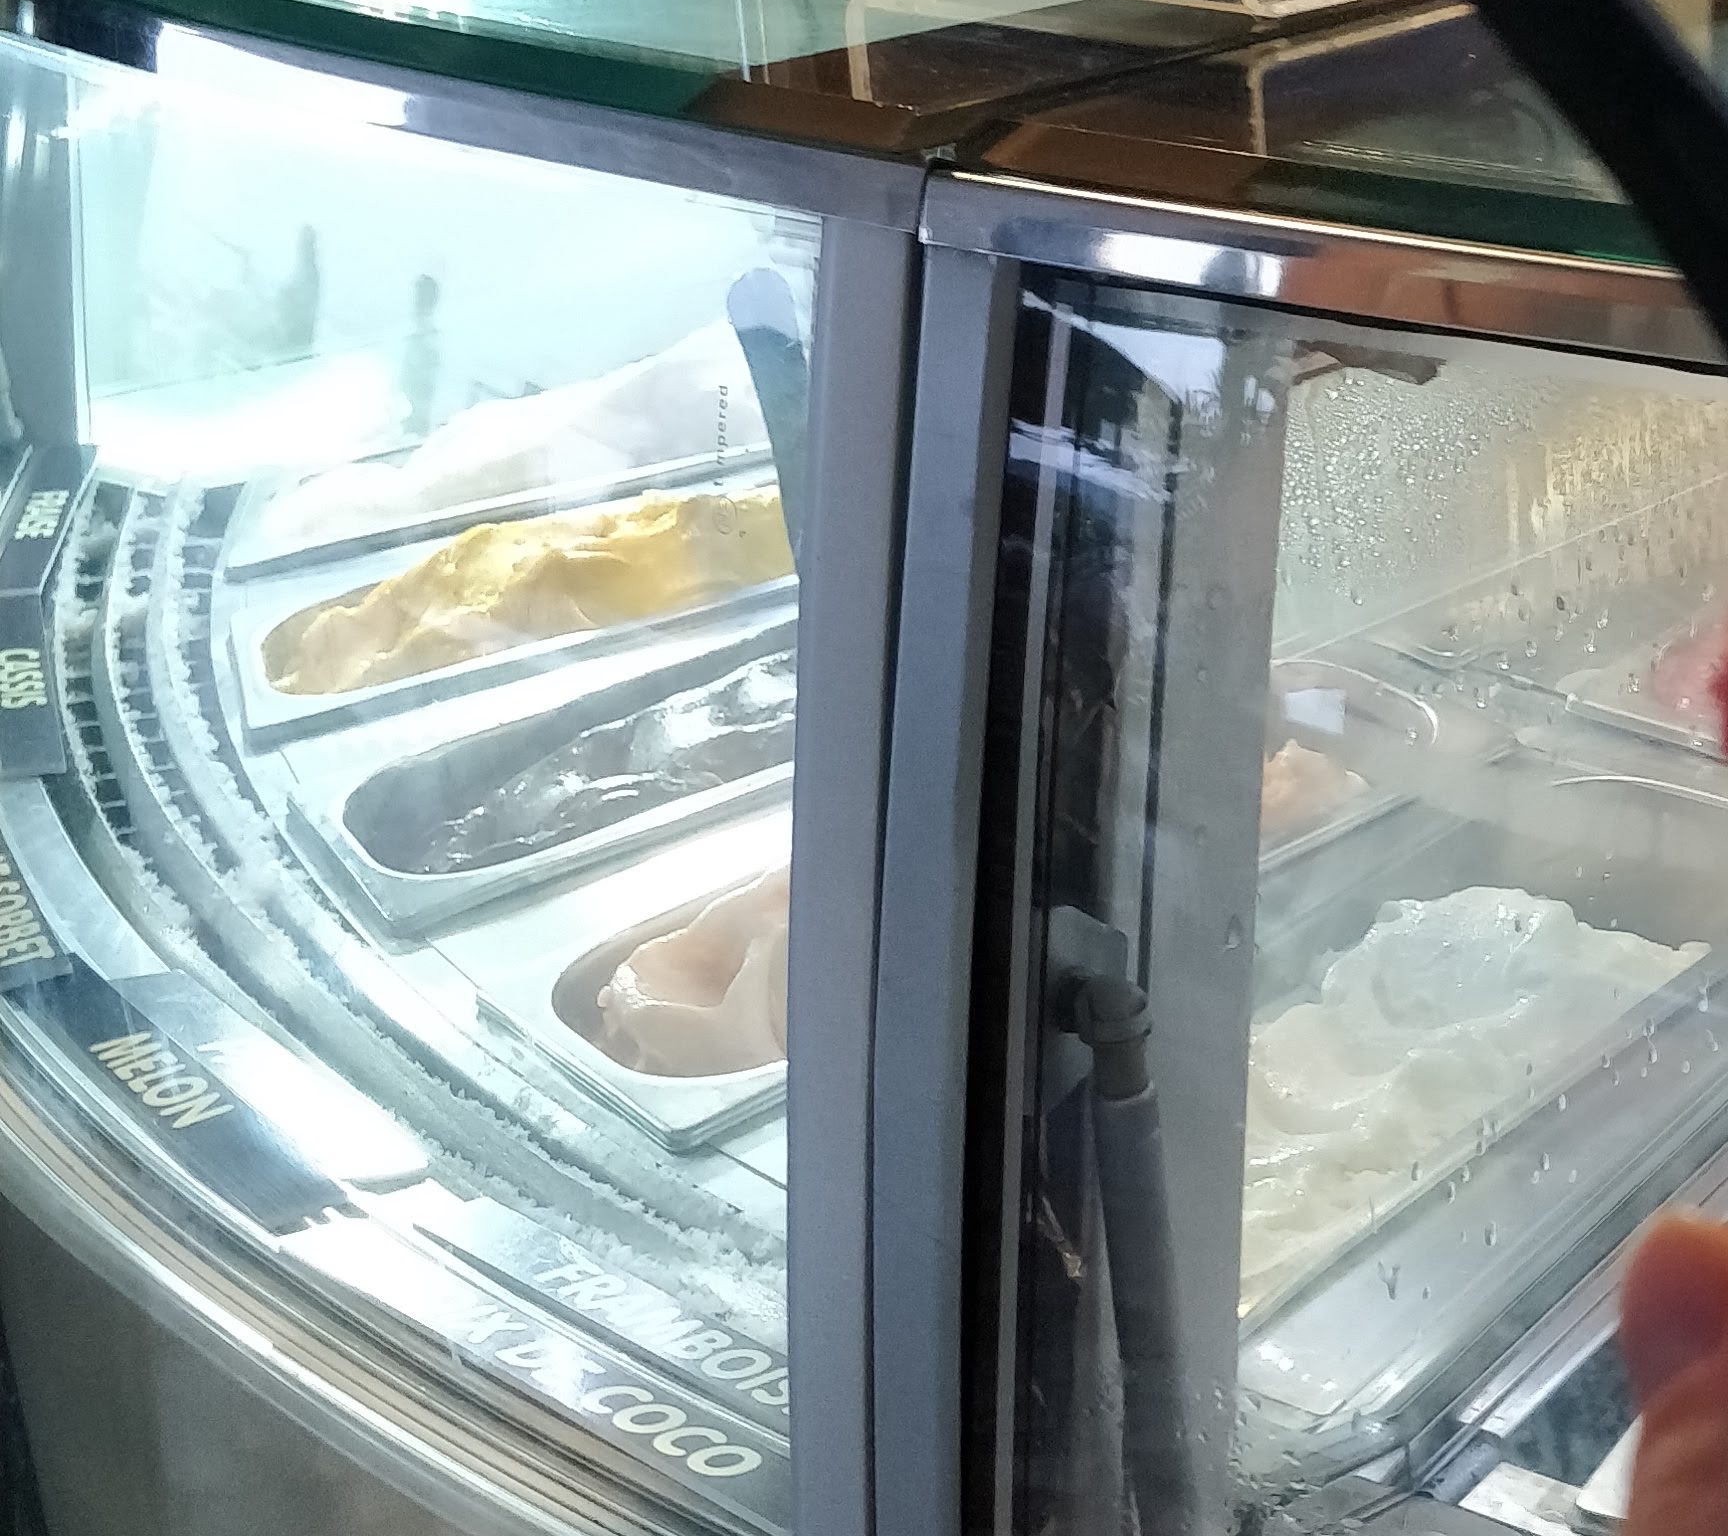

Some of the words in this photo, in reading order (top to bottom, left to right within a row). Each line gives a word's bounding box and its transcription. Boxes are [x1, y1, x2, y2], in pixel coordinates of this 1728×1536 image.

[0, 648, 48, 710] CASSIS
[89, 1031, 236, 1130] MELON
[532, 1262, 790, 1416] FRAMBOIS
[580, 1384, 763, 1478] COCO
